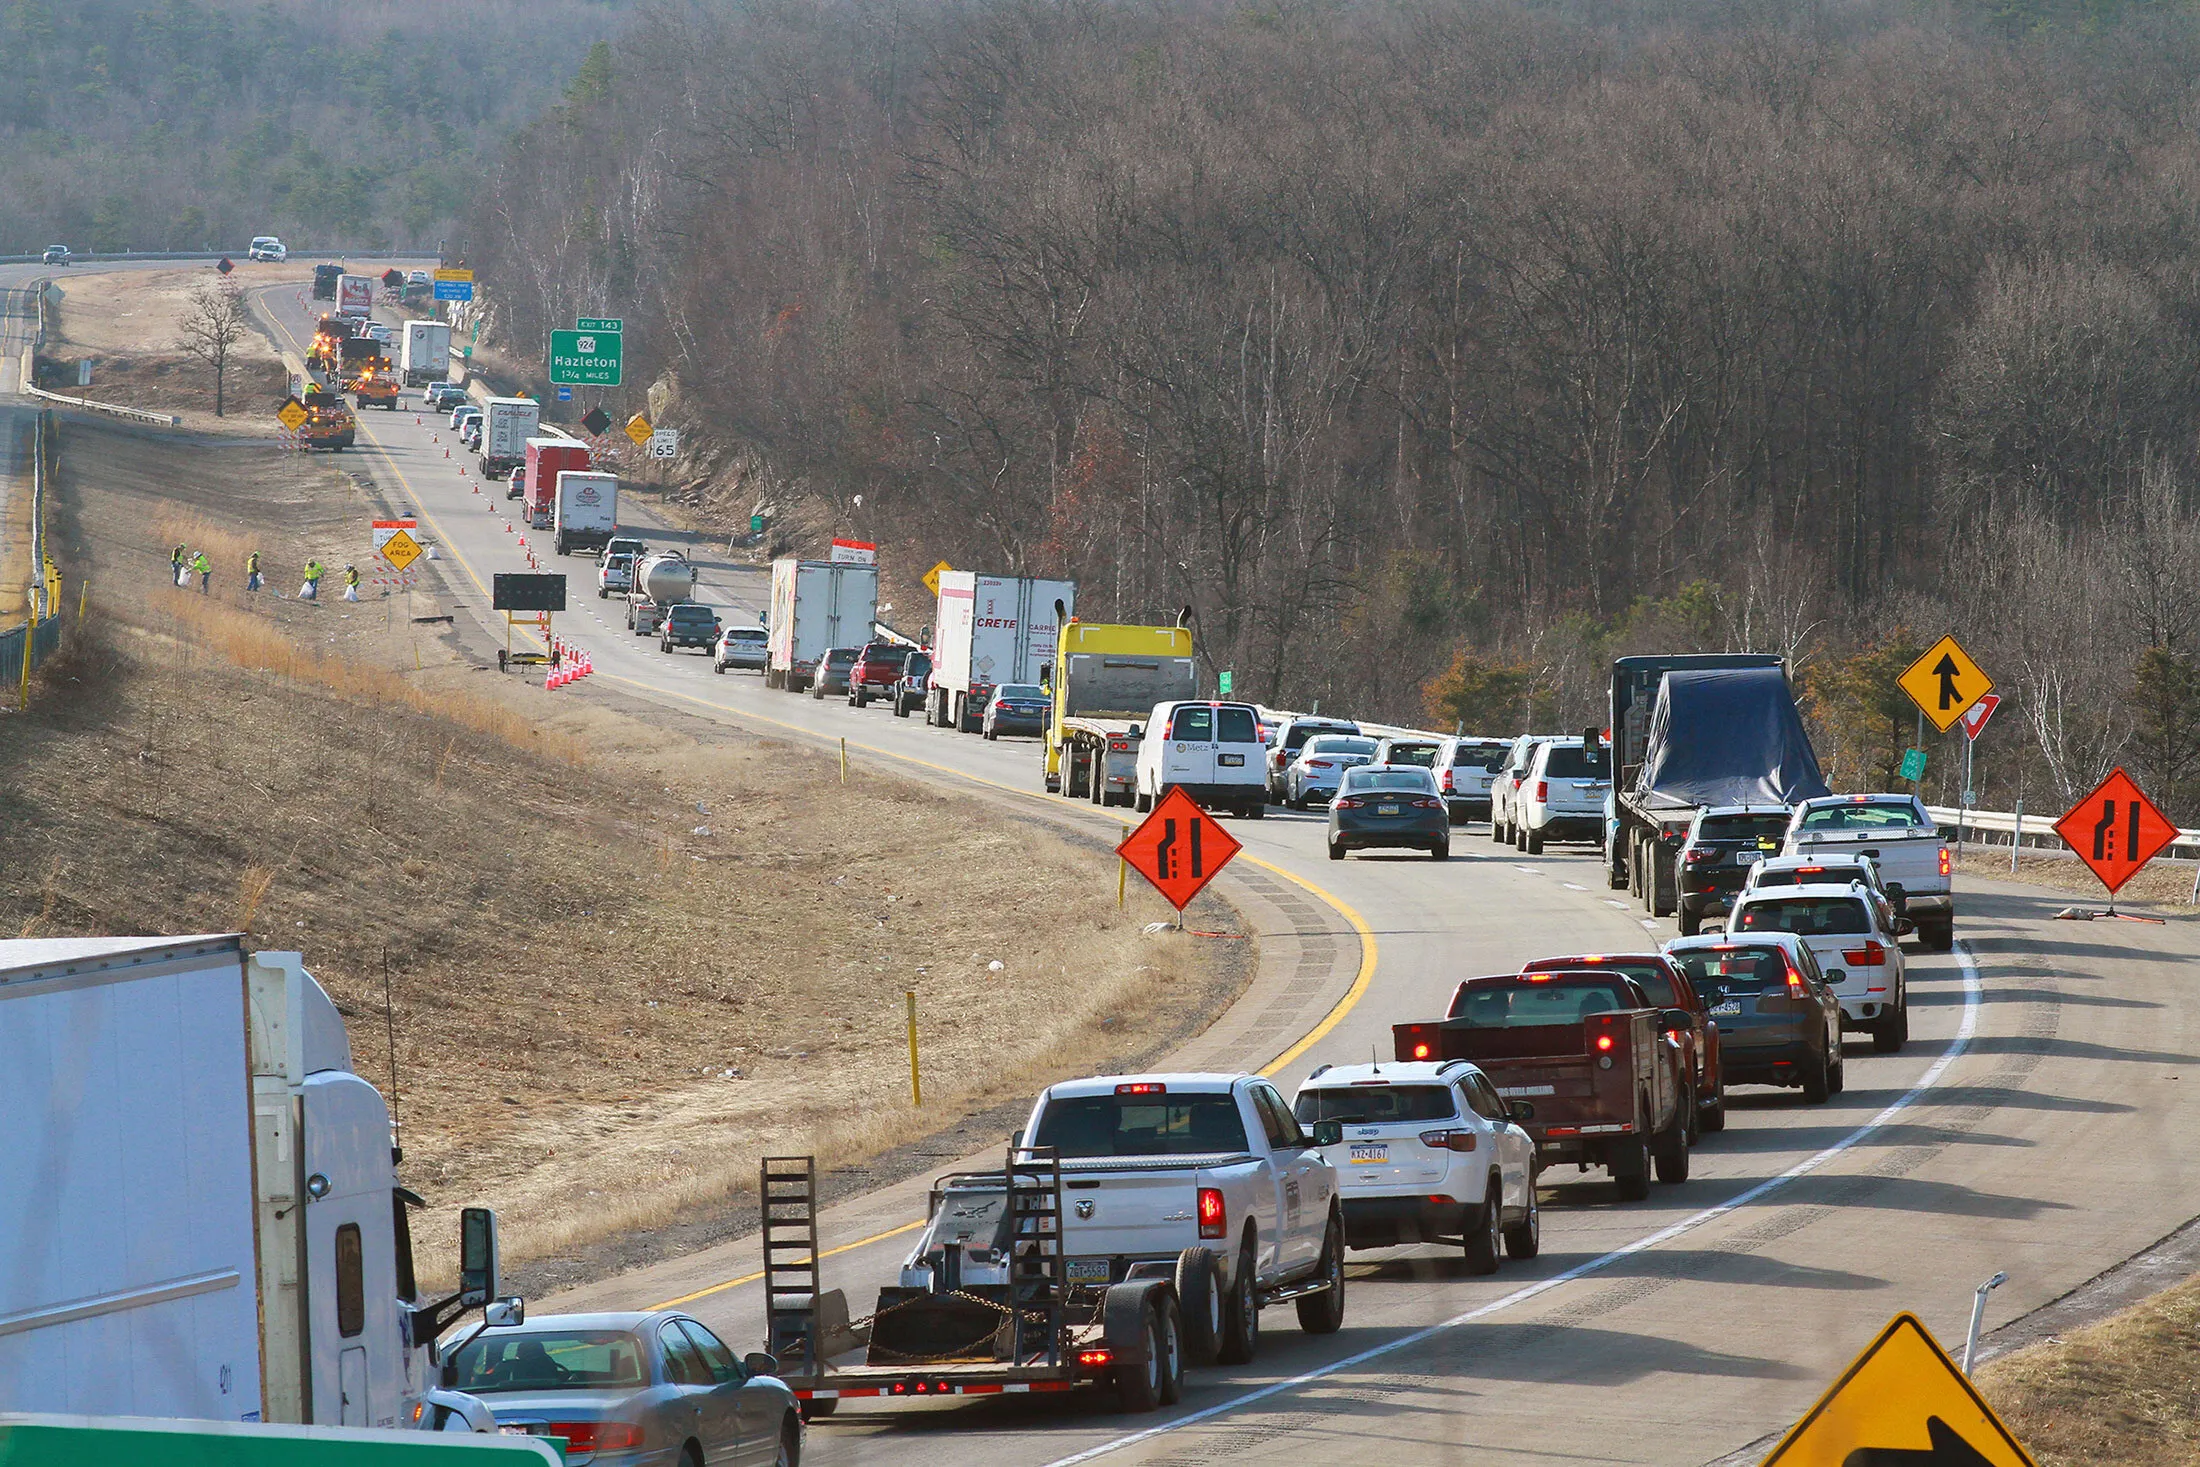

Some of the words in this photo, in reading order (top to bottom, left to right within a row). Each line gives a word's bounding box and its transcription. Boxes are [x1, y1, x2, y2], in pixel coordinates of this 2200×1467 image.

[601, 321, 618, 329] 143
[578, 340, 594, 350] 924
[555, 356, 617, 368] Hazleton
[586, 372, 610, 380] MILES
[656, 445, 674, 456] 65
[837, 553, 855, 561] TURN
[976, 618, 1017, 629] CRETE
[1357, 1128, 1379, 1136] Jeep
